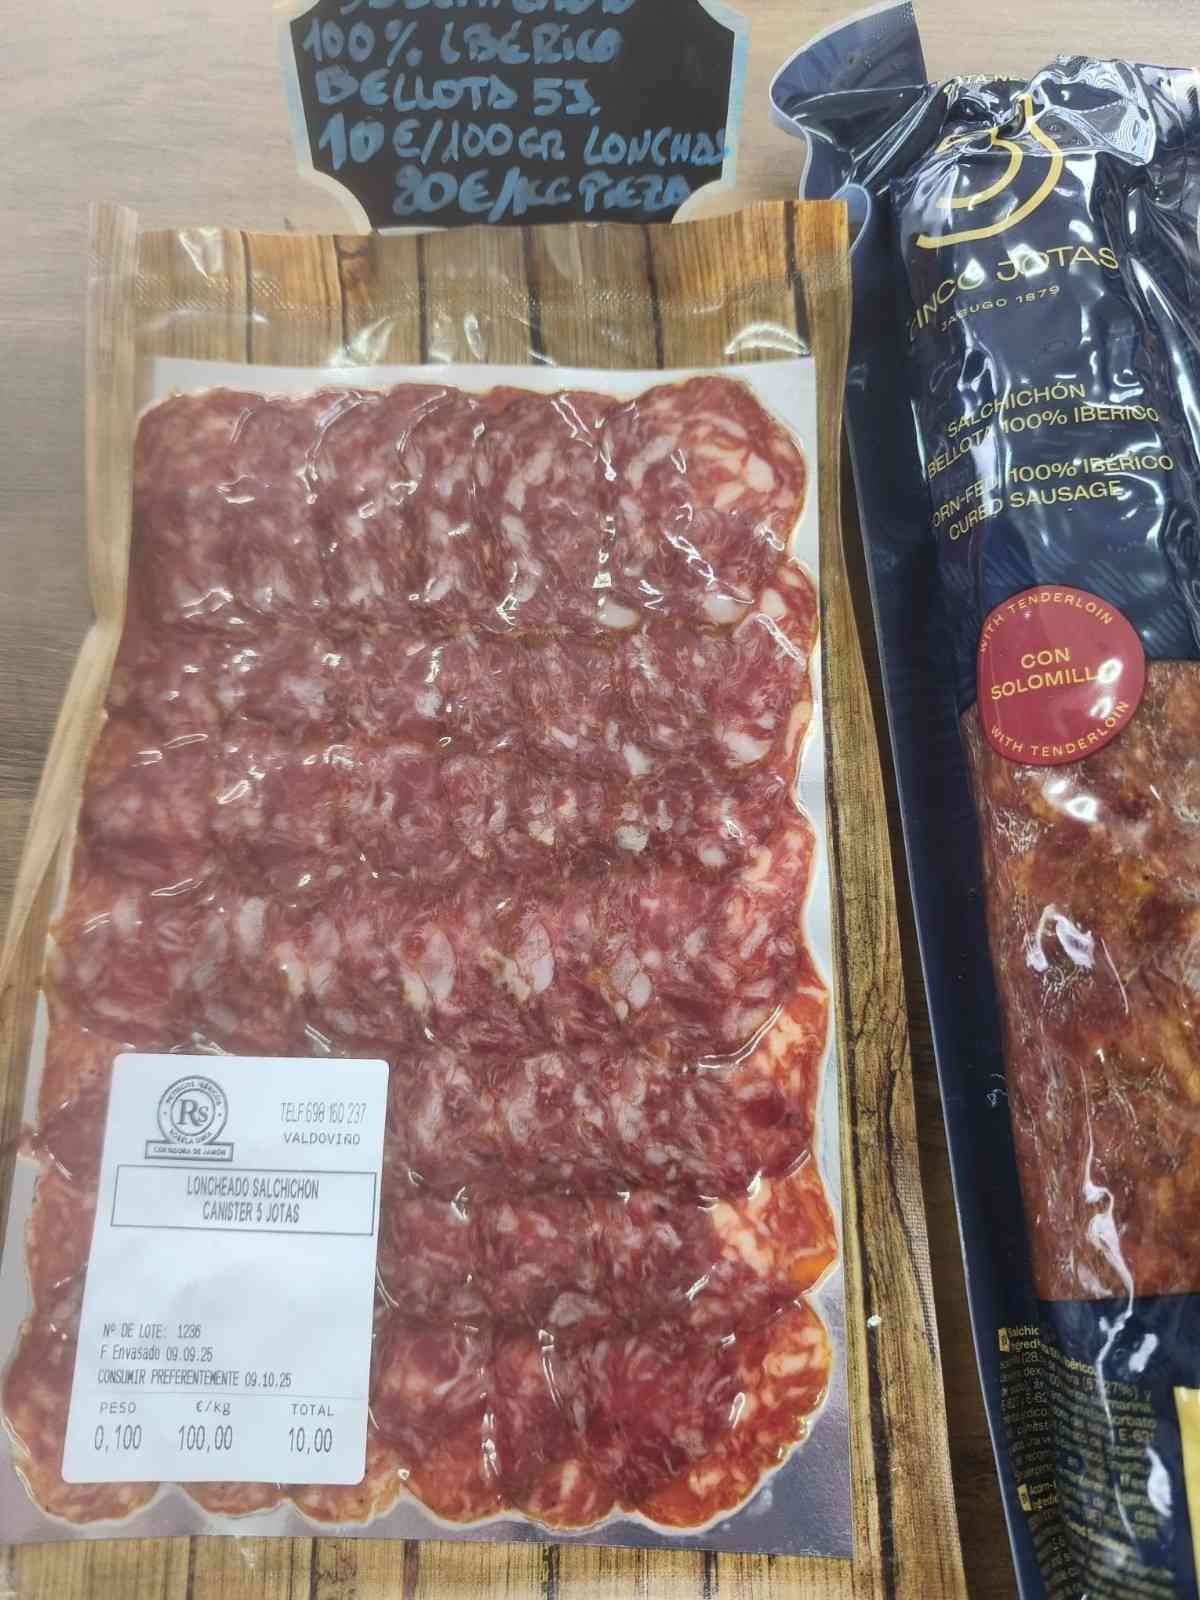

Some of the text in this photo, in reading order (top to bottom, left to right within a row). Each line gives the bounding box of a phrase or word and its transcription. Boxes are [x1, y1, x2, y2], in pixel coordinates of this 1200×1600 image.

[1015, 284, 1061, 304] 1879
[999, 409, 1067, 434] 100%
[1008, 461, 1077, 483] 100%
[1009, 480, 1122, 508] SAUSAGE
[1007, 592, 1113, 625] TENDERLOIN
[1020, 647, 1072, 669] CON
[991, 700, 1129, 757] WITH TENDERLOIN
[187, 1175, 319, 1200] LONCHEADO SALCHICHON
[202, 1202, 300, 1224] CANISTER 5 JOTAS
[120, 1323, 134, 1338] DE
[112, 1345, 160, 1361] Envasado
[166, 1347, 213, 1363] 09.09.25
[97, 1368, 292, 1388] CONSUMIR PREFERENTEMENTE 09.10.25
[99, 1402, 137, 1415] PESO
[291, 1403, 335, 1417] TOTAL
[94, 1424, 143, 1453] 0,100
[178, 1424, 233, 1453] 100,00
[288, 1427, 333, 1454] 10,00
